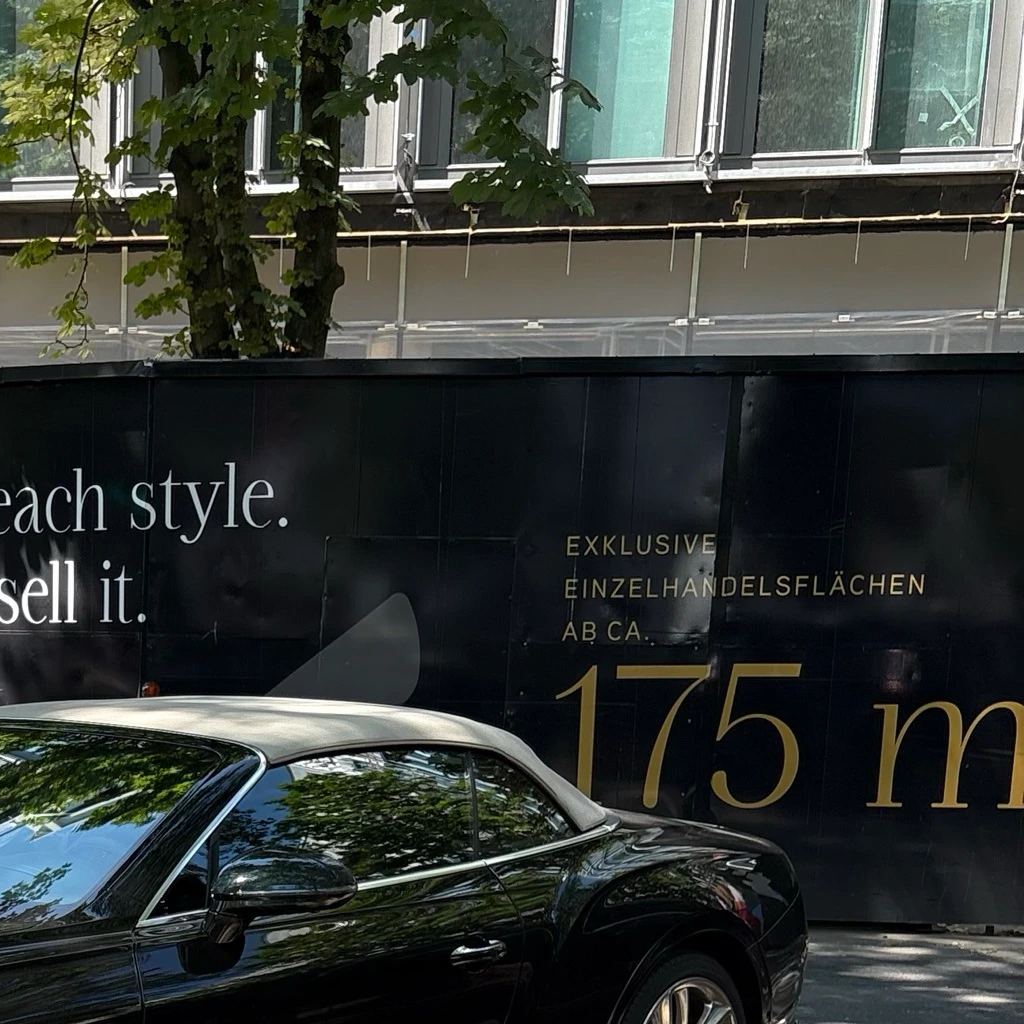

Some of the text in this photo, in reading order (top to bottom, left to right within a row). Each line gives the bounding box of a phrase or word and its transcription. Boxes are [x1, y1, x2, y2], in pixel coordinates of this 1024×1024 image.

[130, 462, 289, 544] style.
[566, 533, 716, 557] EXKLUSIVE
[99, 560, 147, 624] it.
[564, 570, 926, 600] EINZELHANDELSFLÄCHEN
[562, 620, 650, 642] AB CA.
[555, 663, 802, 810] 175
